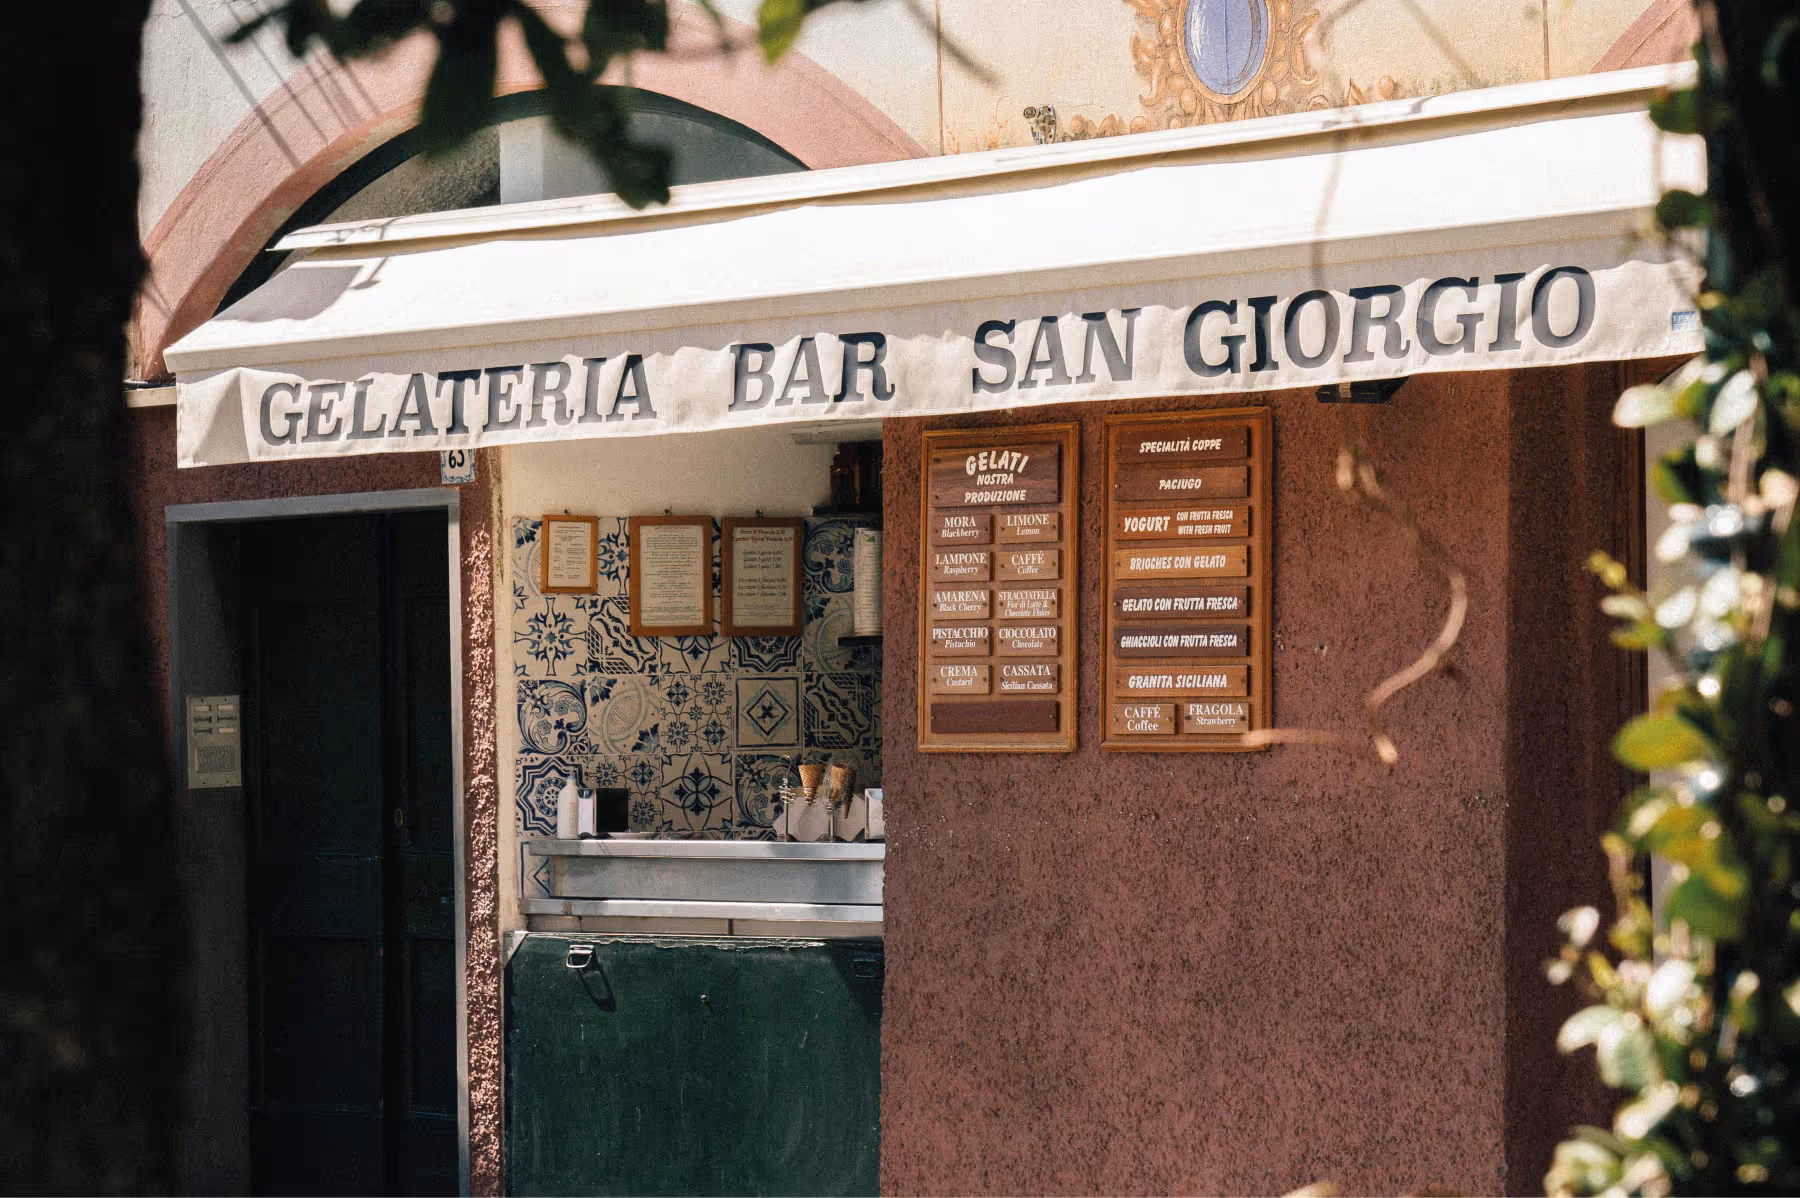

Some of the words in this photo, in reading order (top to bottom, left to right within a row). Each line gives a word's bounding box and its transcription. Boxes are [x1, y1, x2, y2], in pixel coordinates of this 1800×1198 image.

[259, 353, 657, 446] GELATERIA
[728, 331, 896, 413] BAR
[971, 307, 1142, 394] SAN
[1183, 265, 1597, 377] GIORGIO
[1140, 437, 1189, 453] SPECIALITÀ
[1193, 439, 1222, 450] COPPE
[966, 451, 1029, 475] GELATI
[977, 474, 1013, 485] NOSTRA
[1159, 479, 1201, 490] PACIUGO
[965, 490, 1026, 503] PRODUZIONE
[1007, 514, 1049, 526] LIMONE
[1177, 512, 1188, 521] CON
[1190, 511, 1211, 521] FRUTTA
[1212, 510, 1233, 520] FRESCA
[945, 517, 976, 528] MORA
[1124, 516, 1170, 532] YOGURT
[942, 529, 979, 538] Blackberry
[1178, 525, 1193, 535] WITH
[1195, 525, 1212, 534] FRESH
[1214, 524, 1231, 534] FRUIT
[936, 553, 986, 565] LAMPONE
[1130, 557, 1172, 570] BRIOCHES
[1174, 556, 1192, 568] CON
[1194, 555, 1226, 568] GELATO
[944, 565, 978, 575] Raspberry
[1017, 566, 1039, 574] Coffee
[935, 591, 985, 602] AMARENA
[999, 591, 1056, 600] STRACCIATELLA
[959, 603, 981, 613] Cherry
[1123, 599, 1152, 611] GELATO
[1155, 598, 1171, 611] CON
[1174, 598, 1204, 611] FRUTTA
[1207, 597, 1237, 610] FRESCA
[933, 628, 988, 639] PISTACCHIO
[999, 628, 1056, 638] CIOCCOLATO
[945, 640, 976, 648] Pistachio
[1012, 640, 1043, 648] Chocolate
[1121, 636, 1162, 648] GHIACCIOLI
[1164, 635, 1179, 647] CON
[1180, 635, 1207, 647] FRUTTA
[1209, 635, 1237, 647] FRESCA
[940, 666, 978, 677] CREMA
[1003, 666, 1051, 676] CASSATA
[947, 678, 973, 686] Custard
[1001, 682, 1025, 690] Sicilian
[1027, 681, 1052, 689] Cassata
[1129, 675, 1172, 689] GRANITA
[1176, 675, 1227, 688] SICILIANA
[1189, 704, 1243, 715] FRAGOLA
[1127, 720, 1158, 731] Coffee
[1196, 717, 1237, 727] Strawberry
